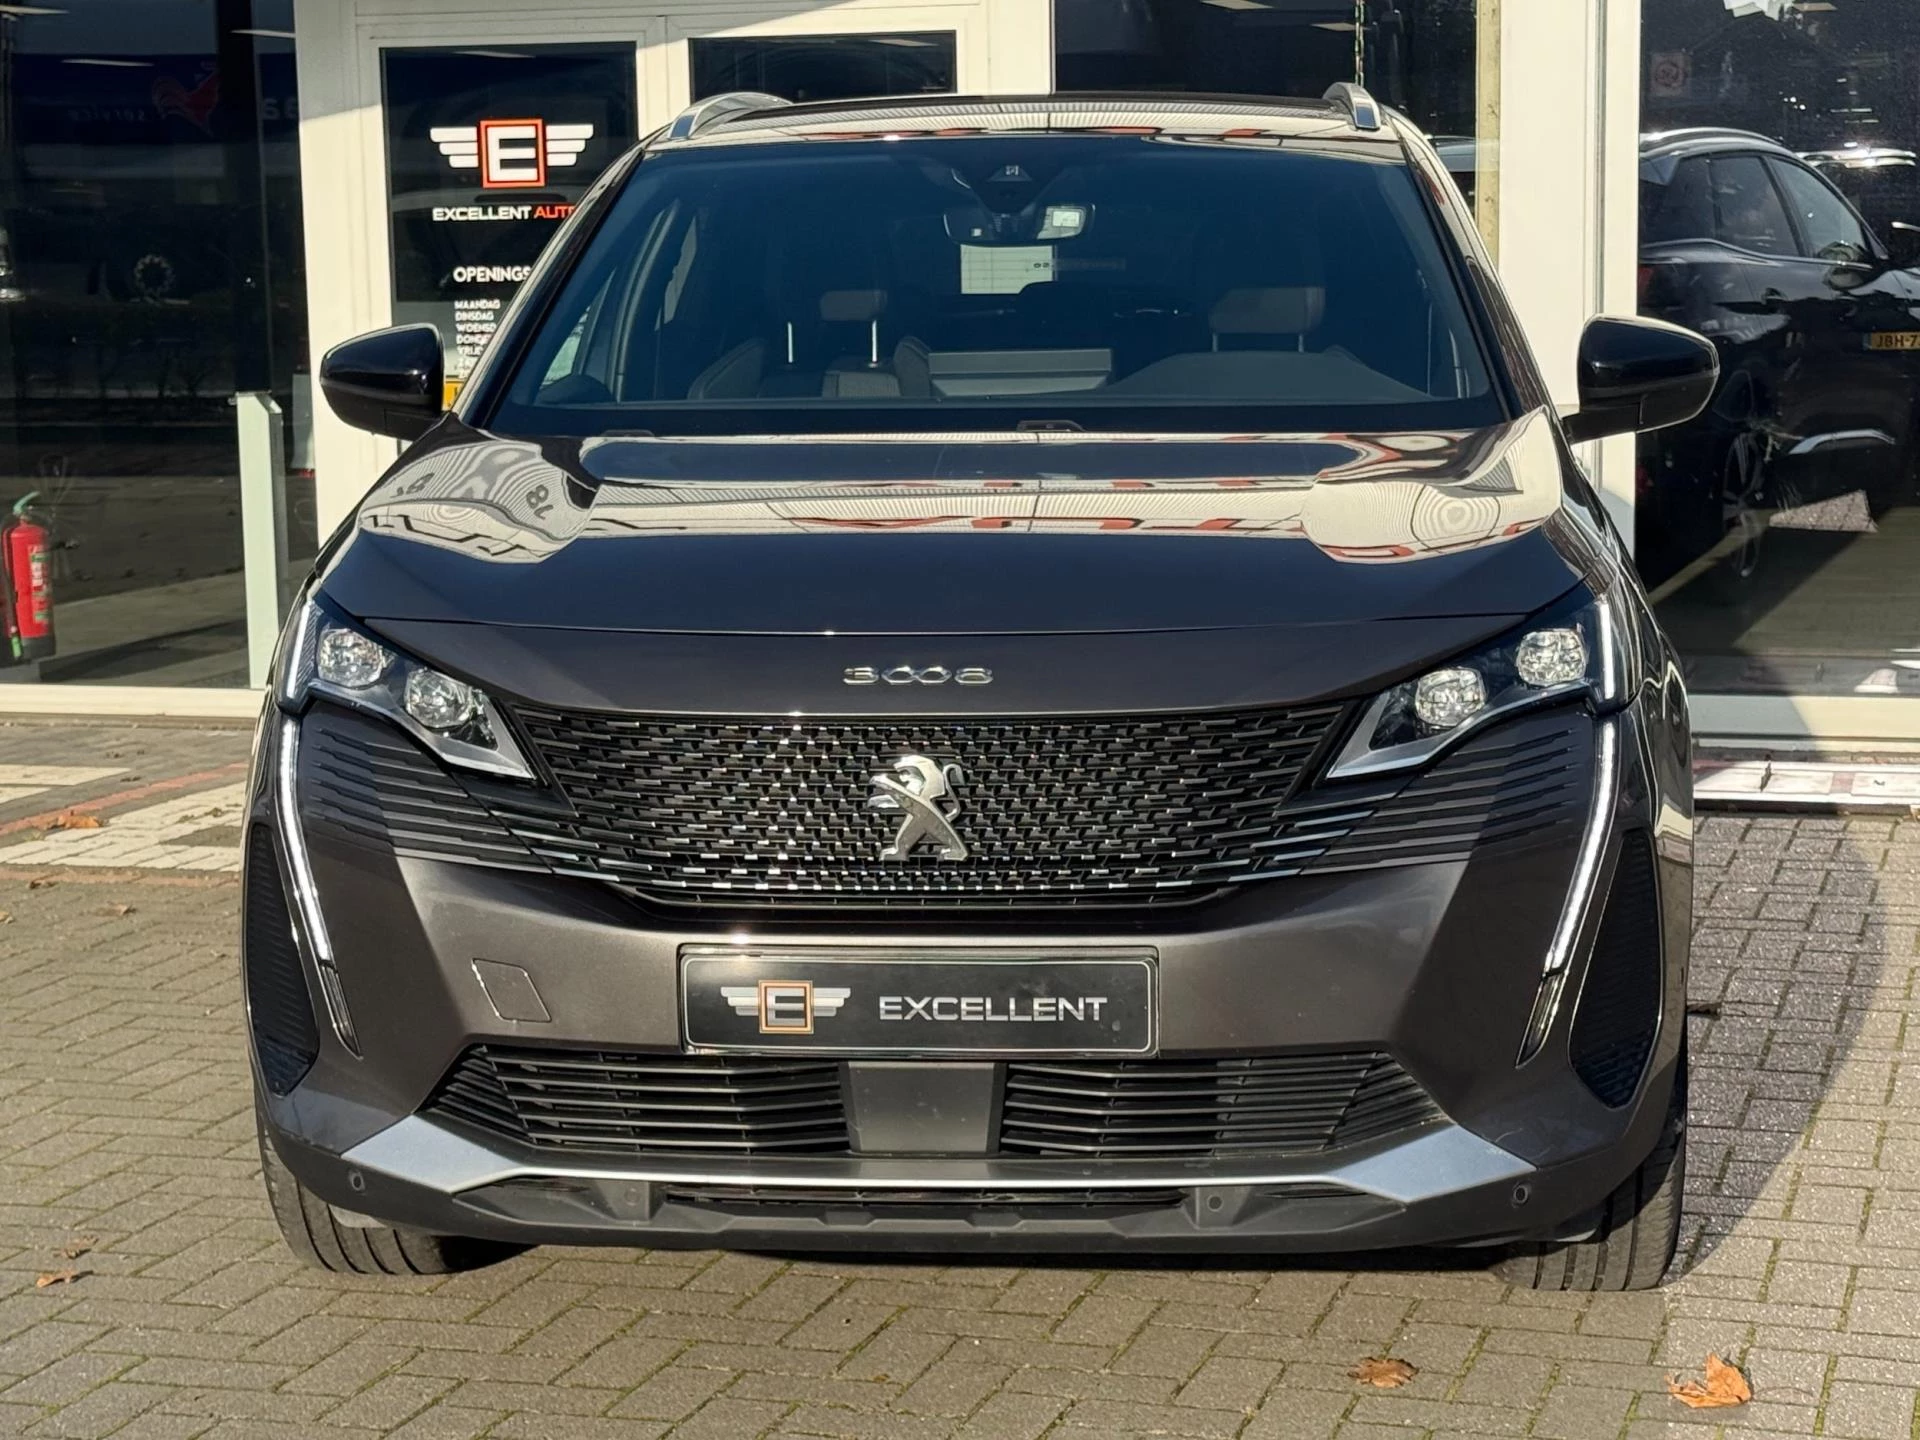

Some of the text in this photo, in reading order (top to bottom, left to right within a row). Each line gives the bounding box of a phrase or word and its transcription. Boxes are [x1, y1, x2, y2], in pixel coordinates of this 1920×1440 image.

[485, 124, 538, 183] E
[432, 205, 532, 221] EXCELLENT
[453, 266, 532, 283] OPENINGS
[454, 299, 500, 310] MAANDAG
[455, 311, 494, 321] DINSDAG
[1876, 333, 1920, 349] JBH-7
[878, 996, 1107, 1022] EXCELLENT
